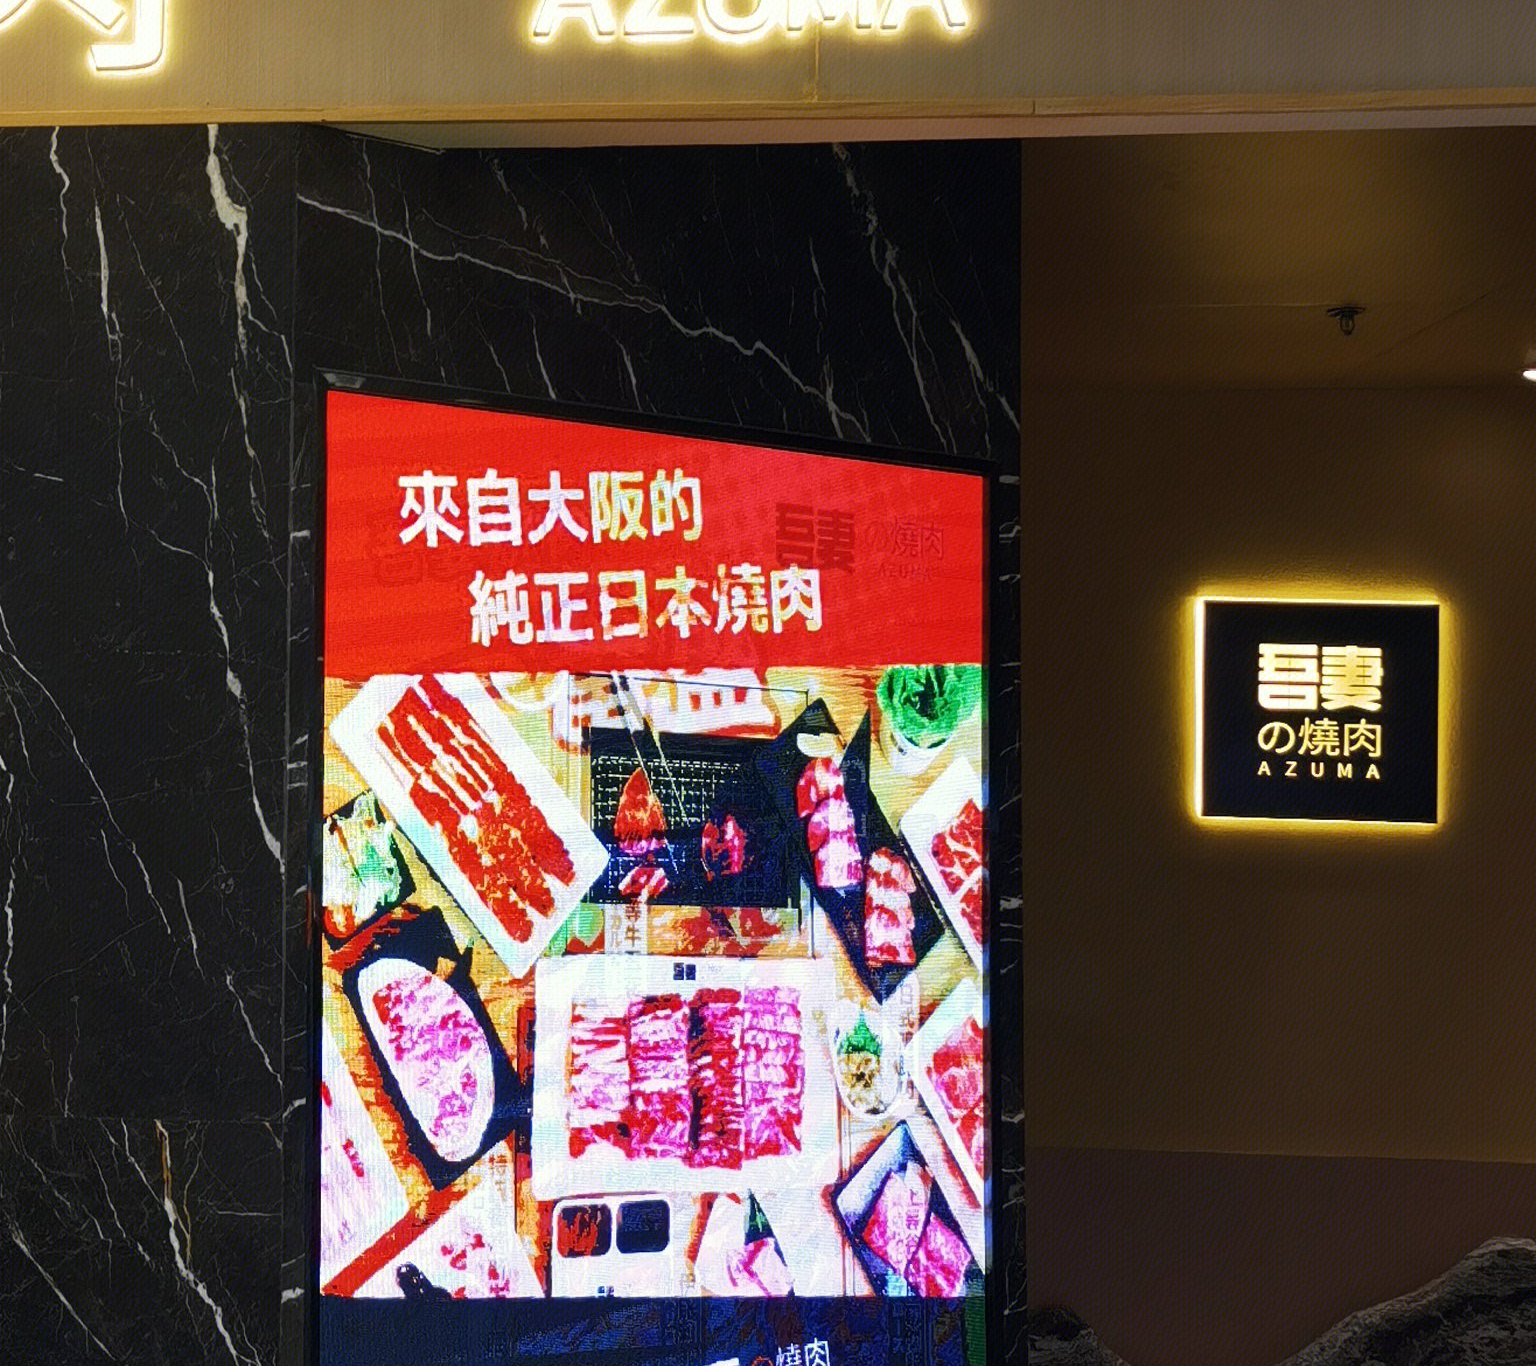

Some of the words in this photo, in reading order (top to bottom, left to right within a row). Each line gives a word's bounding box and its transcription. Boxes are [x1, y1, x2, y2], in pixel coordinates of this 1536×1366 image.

[398, 468, 702, 548] 來自大阪的
[470, 563, 823, 648] 純正日本燒肉
[1257, 760, 1381, 780] AZUMA
